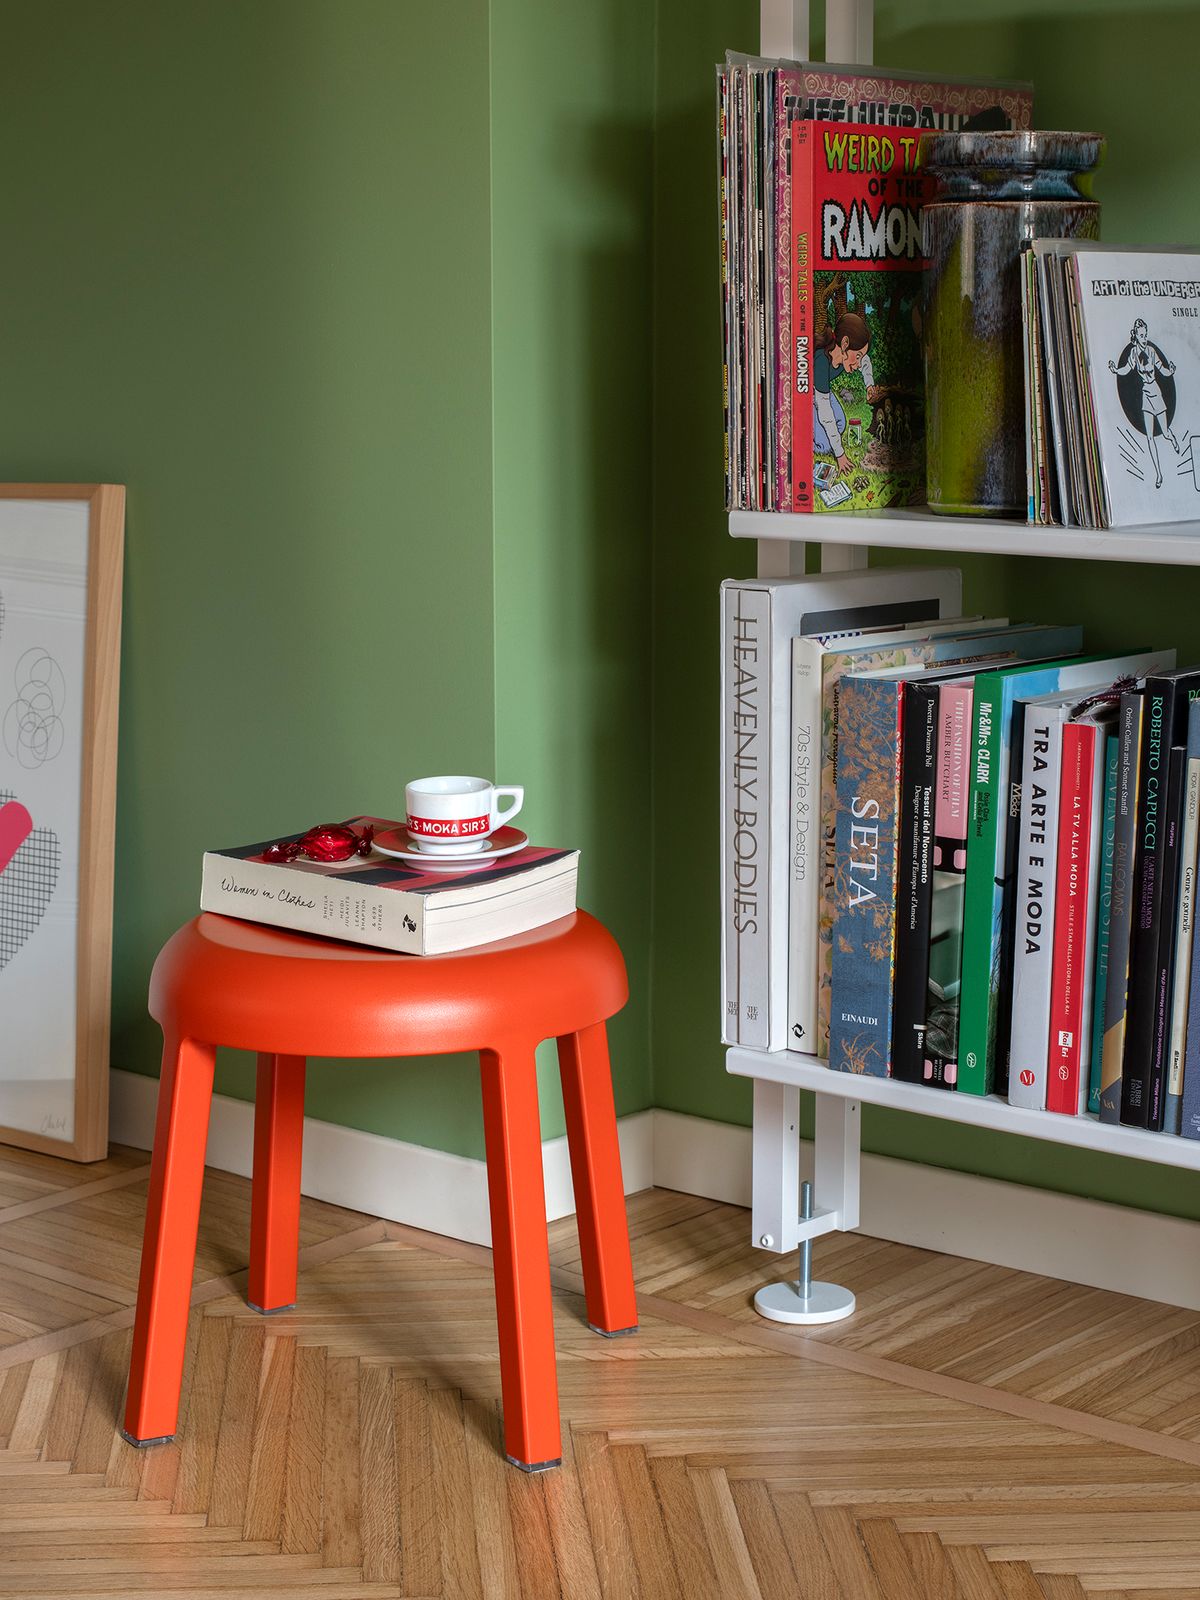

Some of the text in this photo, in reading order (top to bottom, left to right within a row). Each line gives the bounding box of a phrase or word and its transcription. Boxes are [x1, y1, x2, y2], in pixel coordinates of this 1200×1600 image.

[823, 131, 895, 174] WEIRD
[868, 177, 923, 200] OF THE
[822, 199, 924, 262] RAMON
[797, 232, 809, 266] WEIRD
[797, 269, 809, 302] TALES
[1091, 279, 1117, 297] ART
[1118, 279, 1131, 297] of
[1132, 280, 1151, 297] the
[799, 304, 806, 314] OF
[1172, 307, 1199, 318] SINGLE
[796, 336, 809, 393] RAMONES
[924, 699, 935, 767] Doretta Davanzo Poli
[976, 702, 992, 784] Mr&Mrs CLARK
[941, 713, 953, 802] AMBER BUTCHART
[950, 699, 965, 818] THE FASHION OF FILM
[1119, 707, 1134, 816] Oriole Cullen and Sonnet Stanfill
[1143, 696, 1164, 850] ROBERTO CAPUCCI
[733, 616, 758, 935] HEAVENLY BODIES
[1107, 759, 1119, 823] SEVEN
[794, 725, 811, 881] 70s Style & Design
[912, 785, 922, 814] Designer
[423, 821, 459, 834] MOKA
[461, 818, 486, 833] SIR'S
[912, 821, 921, 858] manifatture
[921, 786, 932, 884] Tessuti del Novecento
[1025, 726, 1050, 955] TRA ARTE E MODA
[1168, 821, 1176, 847] Metafore
[847, 796, 880, 910] SETA
[1069, 796, 1081, 897] LA TV ALLA MODA
[221, 875, 316, 909] Women in Clothes
[909, 859, 919, 890] d'Europa
[1112, 842, 1128, 917] BALLGOWNS
[1184, 867, 1194, 894] Gonne
[1145, 856, 1155, 929] L'ARTE NELLA MODA
[910, 896, 919, 930] d'America
[1181, 902, 1190, 934] gonnelle
[841, 1013, 879, 1026] EINAUDI
[1157, 1016, 1165, 1038] Cologni
[1061, 1047, 1069, 1058] Eri
[1155, 1037, 1163, 1069] Fondazione
[1134, 1079, 1143, 1107] FABBRI
